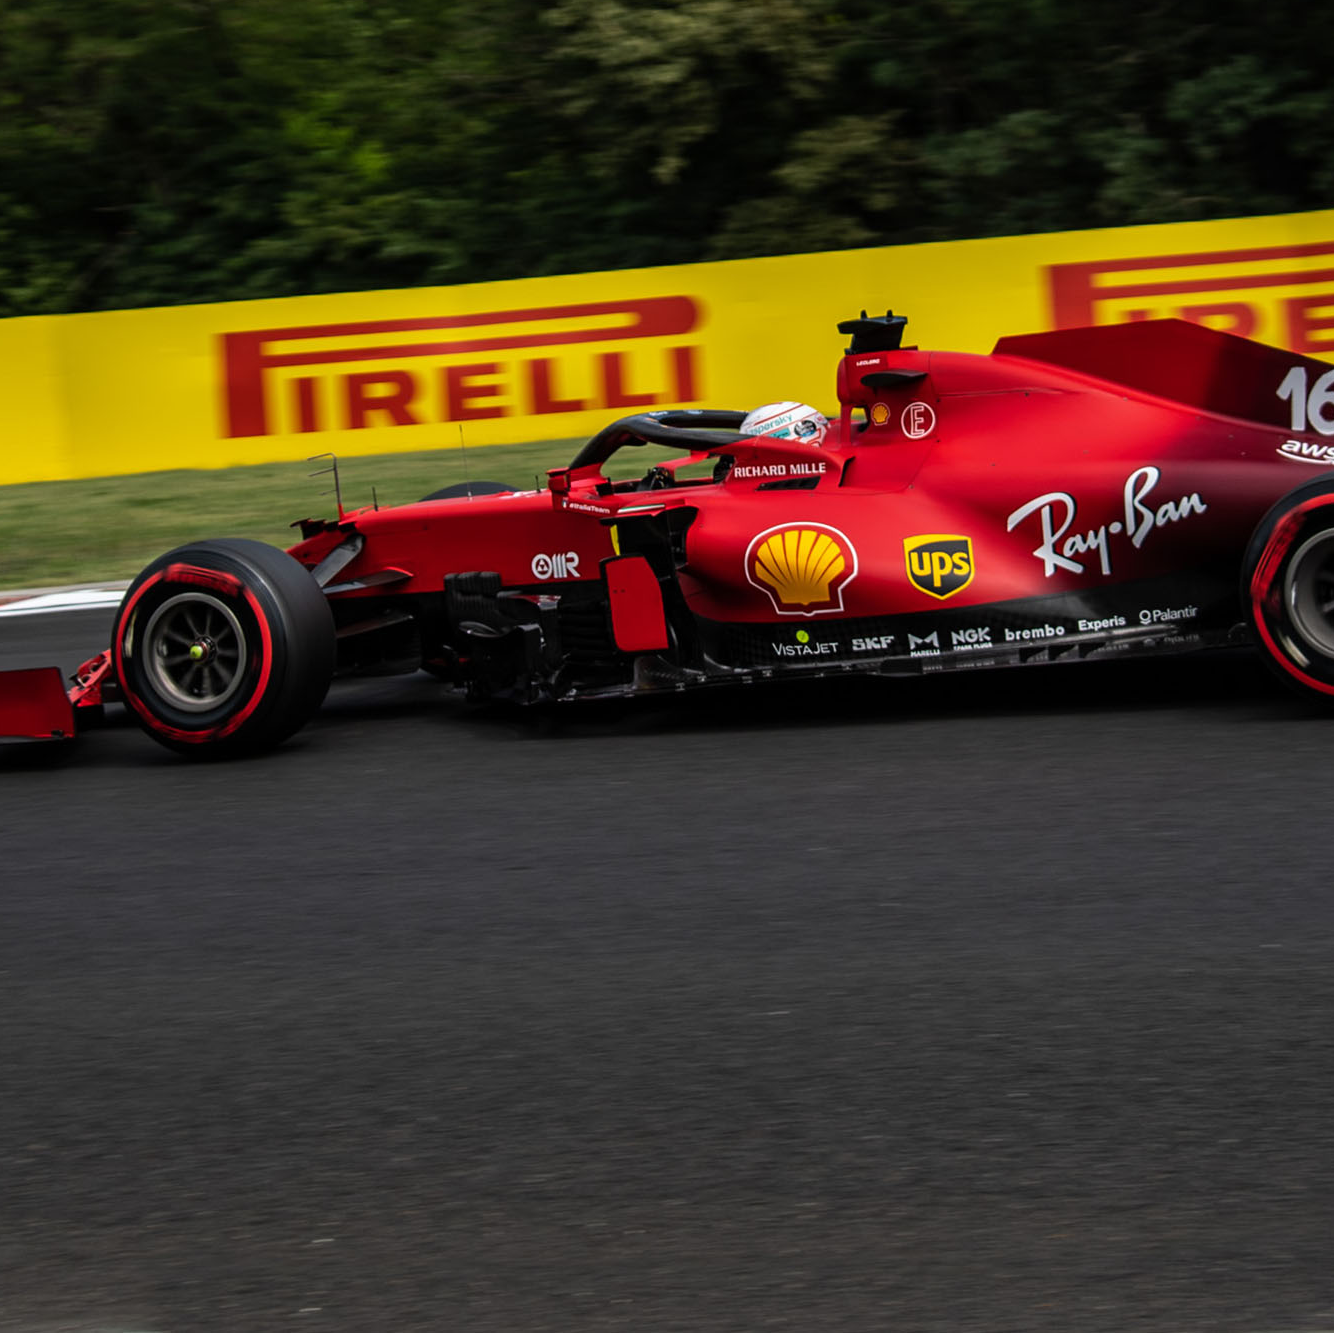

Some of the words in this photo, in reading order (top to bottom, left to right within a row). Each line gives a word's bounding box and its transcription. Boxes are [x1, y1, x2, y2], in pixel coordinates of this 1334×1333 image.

[216, 295, 708, 439] PIRELLI
[734, 464, 786, 478] RICHARD
[789, 462, 827, 475] MILLE
[909, 550, 971, 588] ups
[1152, 605, 1198, 623] Palantir
[1078, 615, 1126, 632] Experis
[951, 626, 991, 645] NGK
[1005, 624, 1065, 641] brembo
[851, 635, 894, 652] SKF
